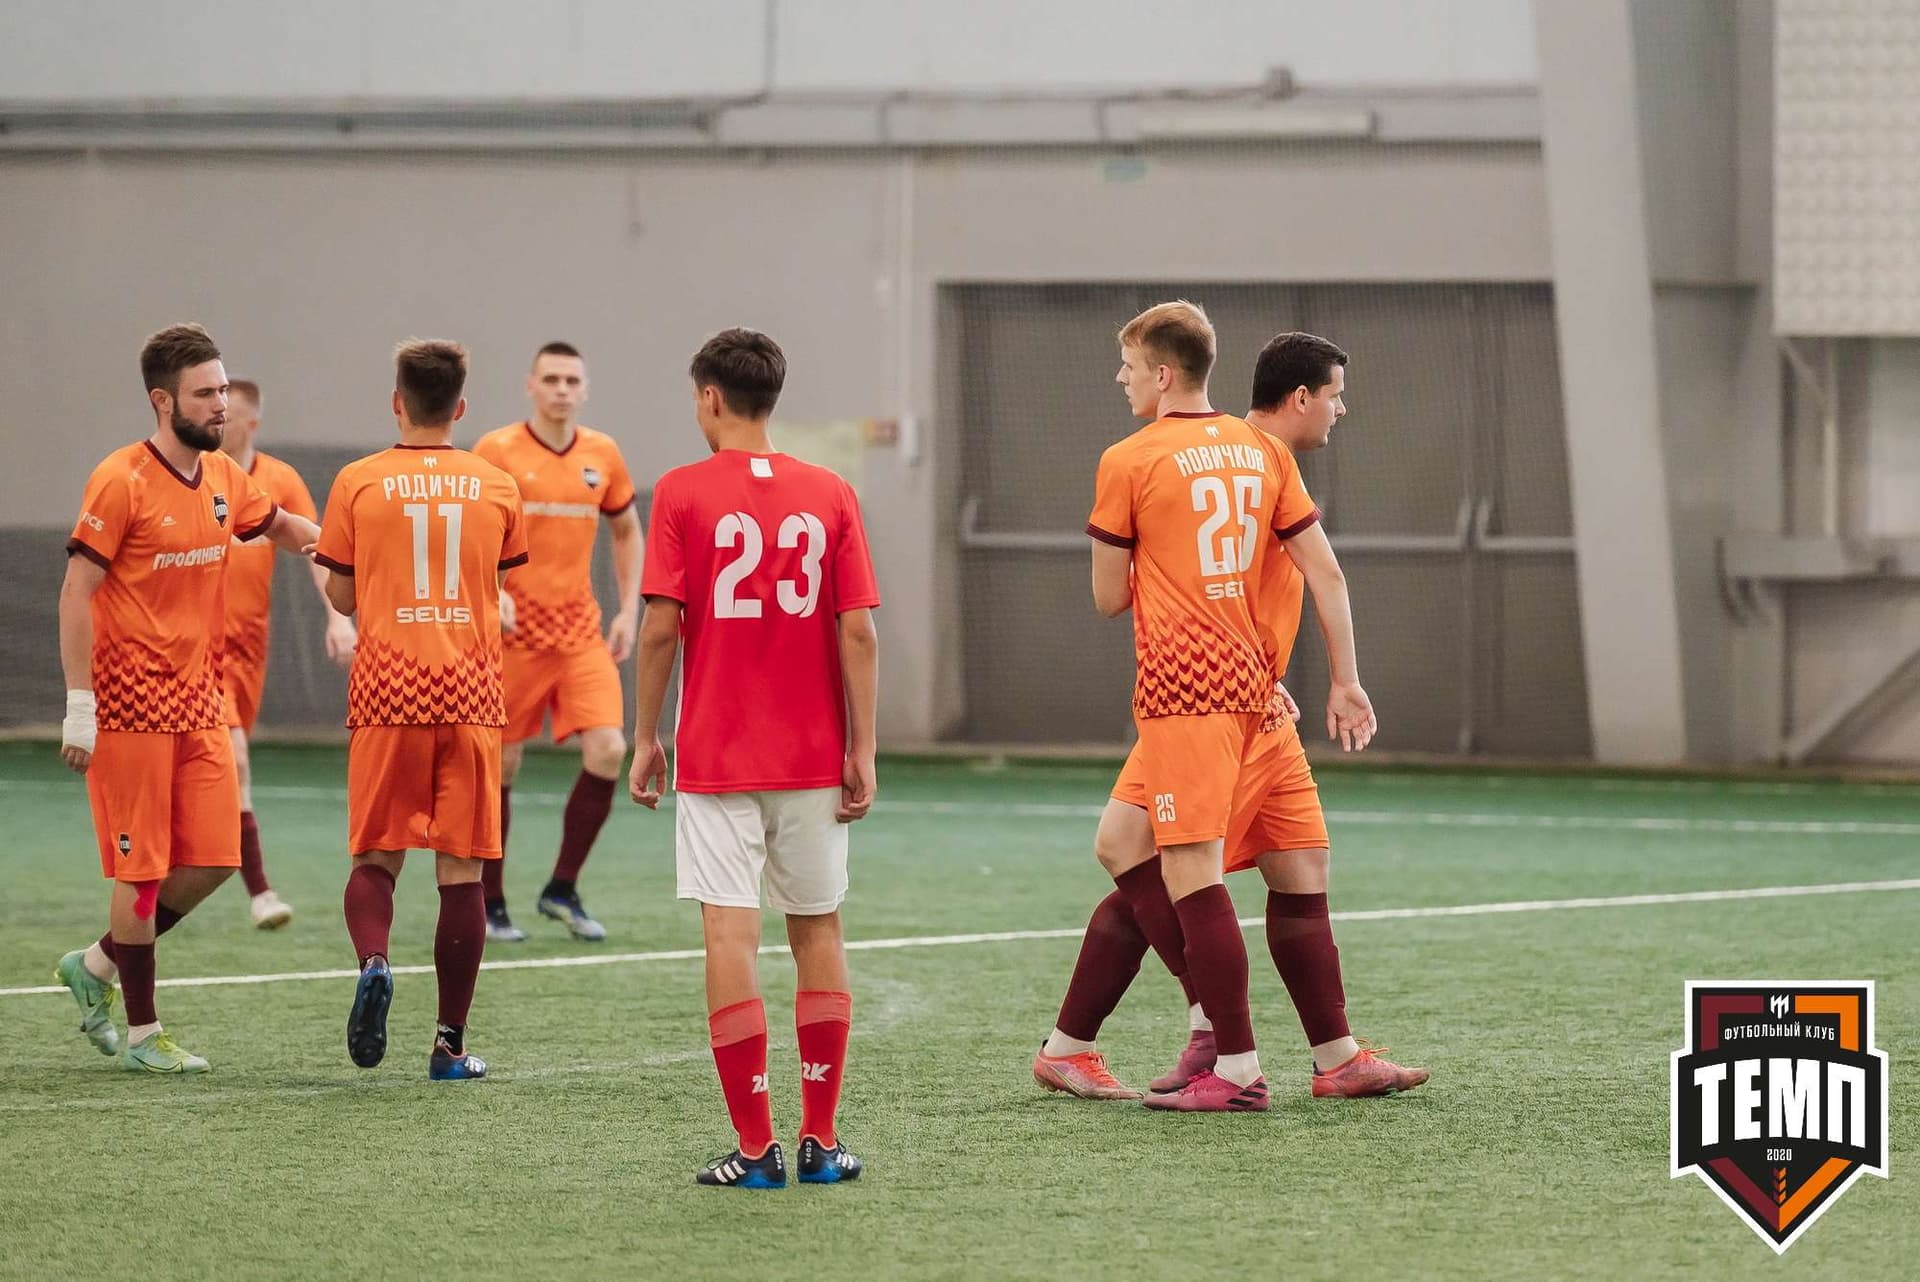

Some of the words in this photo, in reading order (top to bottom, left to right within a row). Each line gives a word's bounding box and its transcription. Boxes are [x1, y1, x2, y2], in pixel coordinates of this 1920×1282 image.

[1172, 444, 1265, 478] НОВИЧКОВ
[382, 473, 482, 501] РОДИЧЕВ
[1190, 475, 1263, 577] 25
[402, 503, 464, 601] 11
[713, 510, 827, 620] 23
[395, 606, 472, 624] SEUS
[1154, 793, 1177, 823] 25
